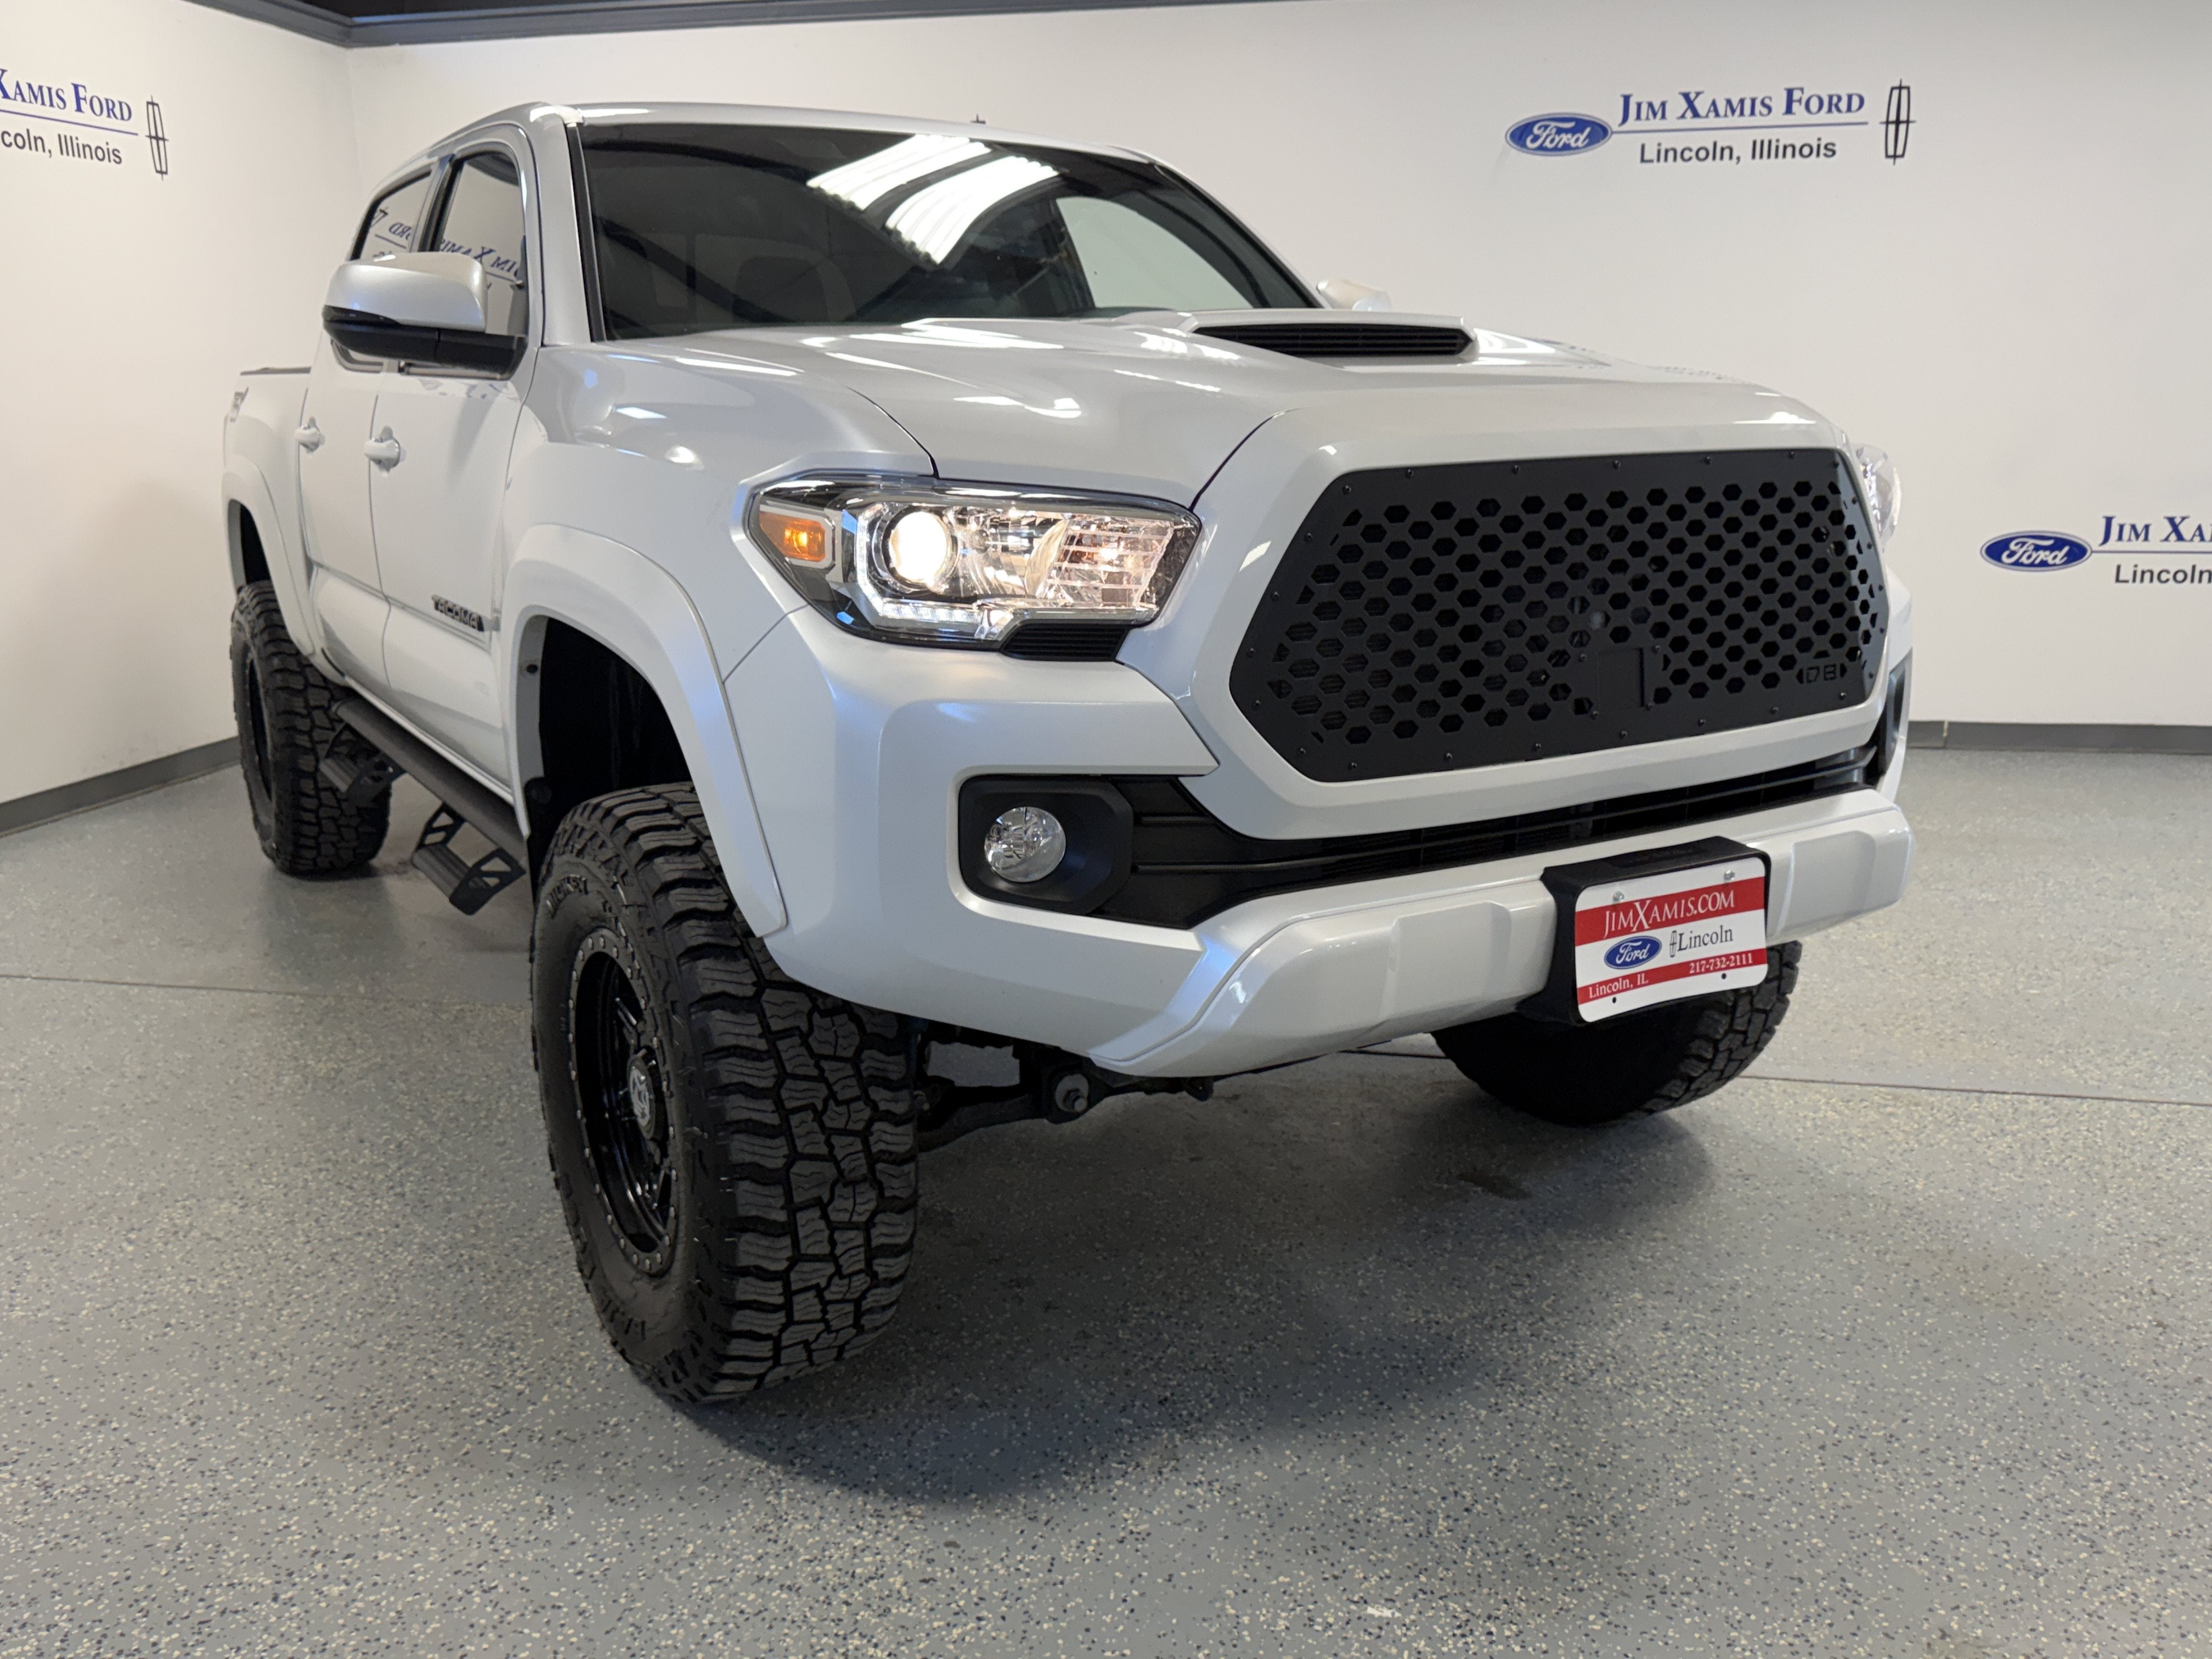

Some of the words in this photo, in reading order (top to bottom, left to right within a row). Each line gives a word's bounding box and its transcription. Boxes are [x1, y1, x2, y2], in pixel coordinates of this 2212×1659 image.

[71, 83, 132, 121] FORD
[1618, 93, 1668, 127] JIM
[1676, 91, 1773, 120] XAMIS
[1782, 87, 1865, 116] FORD
[58, 133, 122, 165] Illinois
[1525, 120, 1591, 149] Ford
[1640, 140, 1741, 165] Lincoln,
[1751, 137, 1837, 160] Illinois
[2098, 515, 2152, 546] JIM
[2160, 515, 2212, 543] XA
[2001, 537, 2068, 565] Ford
[1603, 889, 1735, 939] JIMXAMIS.COM
[1615, 941, 1651, 964] Ford
[1677, 924, 1734, 952] Lincoln
[1689, 952, 1753, 974] 217-732-2111
[1589, 978, 1633, 999] Lincoln,
[1637, 973, 1648, 985] IL
